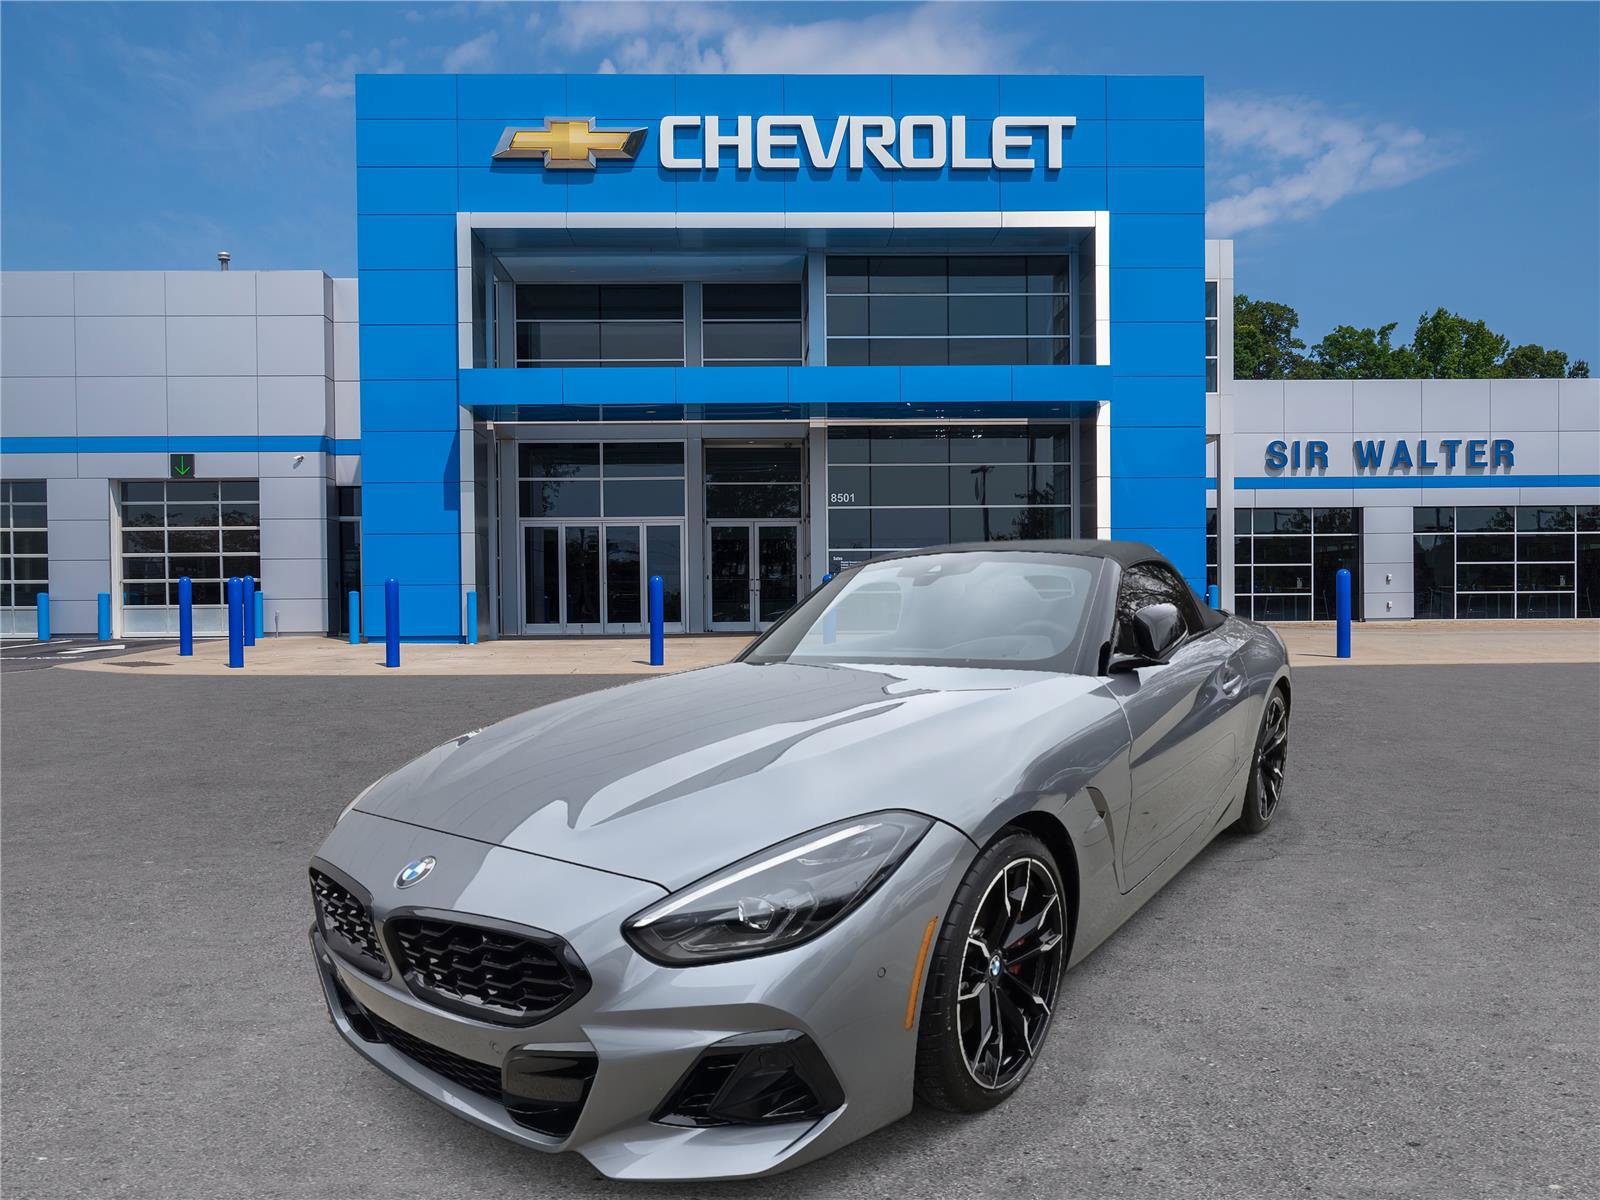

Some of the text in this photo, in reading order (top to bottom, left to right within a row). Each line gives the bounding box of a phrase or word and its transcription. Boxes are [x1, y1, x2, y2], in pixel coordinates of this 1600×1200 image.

[659, 115, 1077, 169] CHEVROLET
[1265, 439, 1515, 471] SIR WALTER
[830, 493, 856, 503] 8501
